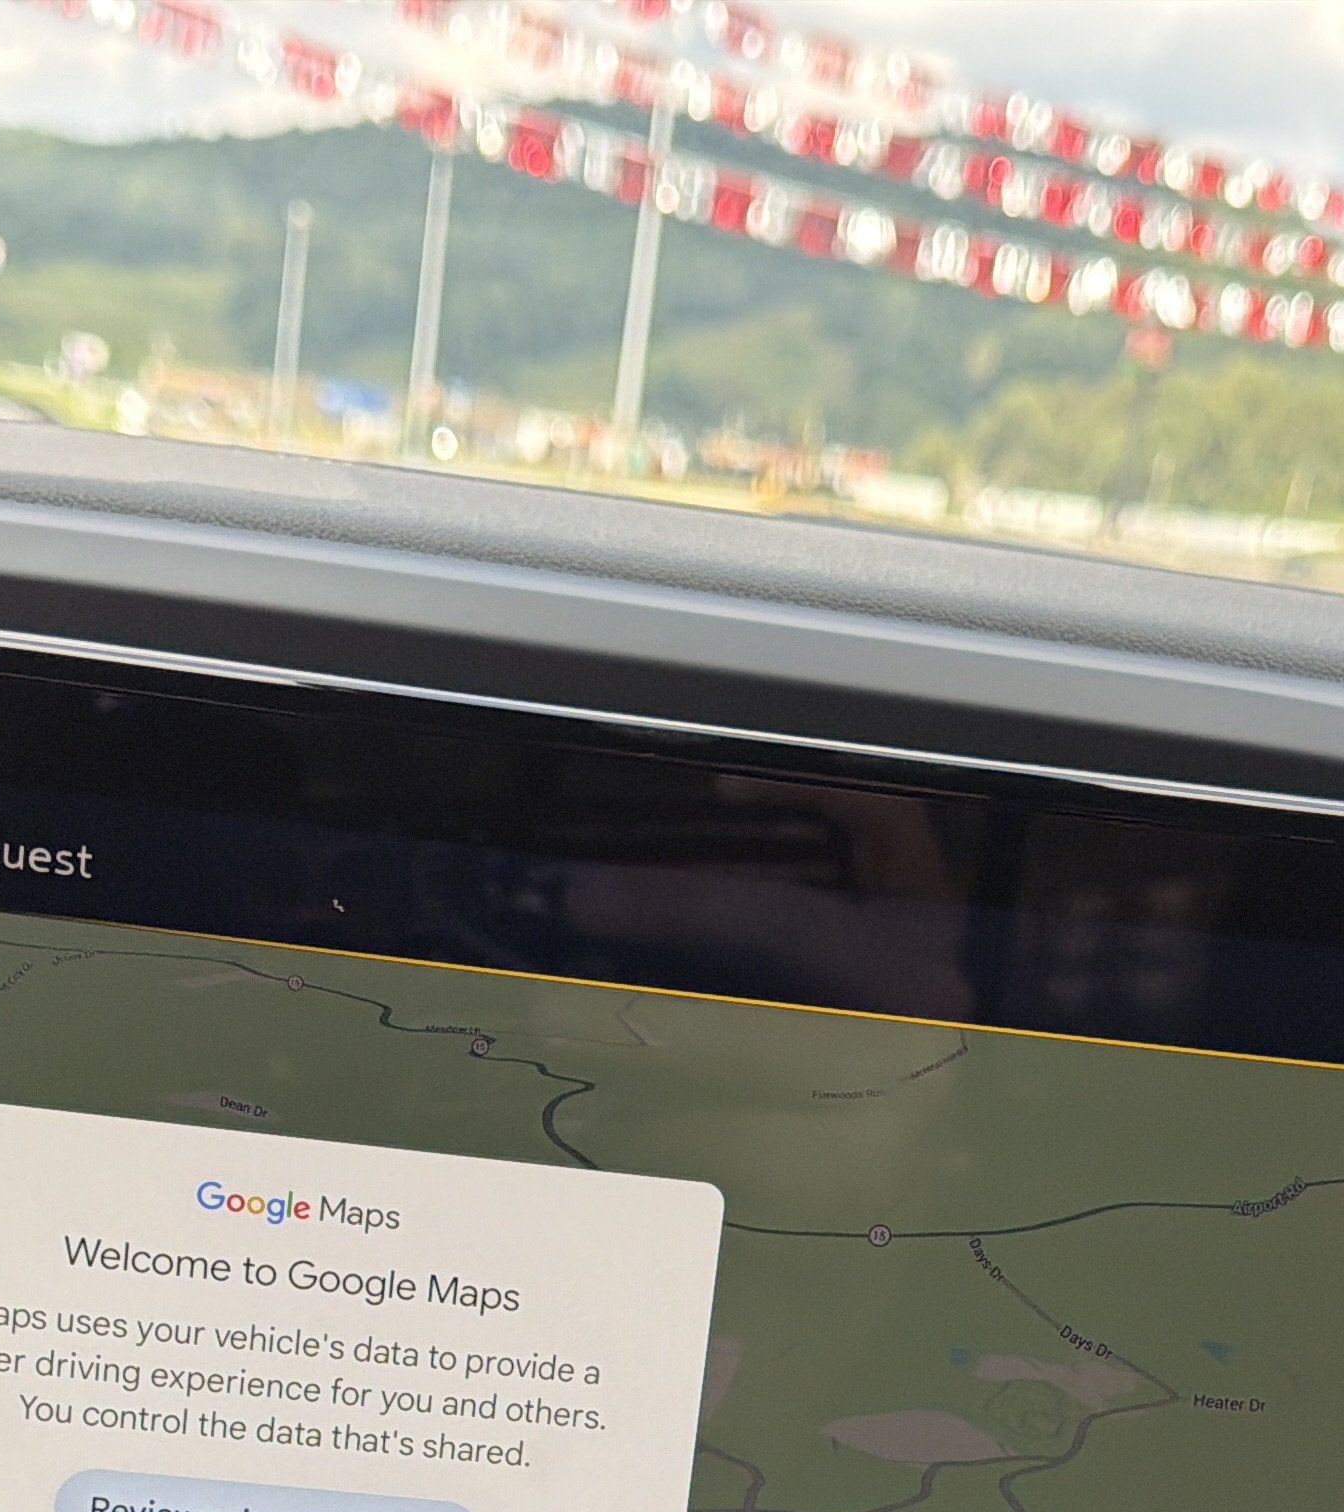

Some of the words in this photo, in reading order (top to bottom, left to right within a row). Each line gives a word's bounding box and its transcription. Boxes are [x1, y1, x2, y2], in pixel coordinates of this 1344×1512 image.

[219, 1096, 250, 1114] Dean
[253, 1105, 269, 1118] Dr
[197, 1180, 311, 1225] Google
[318, 1195, 401, 1234] Maps
[65, 1235, 231, 1284] Welcome
[242, 1254, 278, 1288] to
[287, 1259, 416, 1308] Google
[427, 1273, 521, 1316] Maps
[969, 1238, 992, 1270] Days
[989, 1266, 1005, 1282] Dr
[56, 1310, 128, 1339] uses
[136, 1317, 206, 1349] your
[215, 1320, 345, 1362] vehicle's
[352, 1334, 420, 1368] data
[428, 1343, 458, 1372] to
[465, 1344, 576, 1388] provide
[583, 1362, 601, 1386] a
[1060, 1325, 1092, 1351] Days
[1095, 1343, 1113, 1360] Dr
[35, 1349, 141, 1392] driving
[151, 1364, 322, 1411] experience
[331, 1376, 372, 1409] for
[380, 1386, 433, 1417] you
[442, 1388, 497, 1419] and
[505, 1395, 607, 1431] others.
[1193, 1394, 1245, 1411] Heater
[1249, 1398, 1266, 1412] Dr
[19, 1395, 73, 1426] You
[82, 1401, 188, 1437] control
[197, 1409, 247, 1440] the
[256, 1414, 322, 1448] data
[330, 1423, 414, 1458] that's
[422, 1430, 532, 1467] shared.
